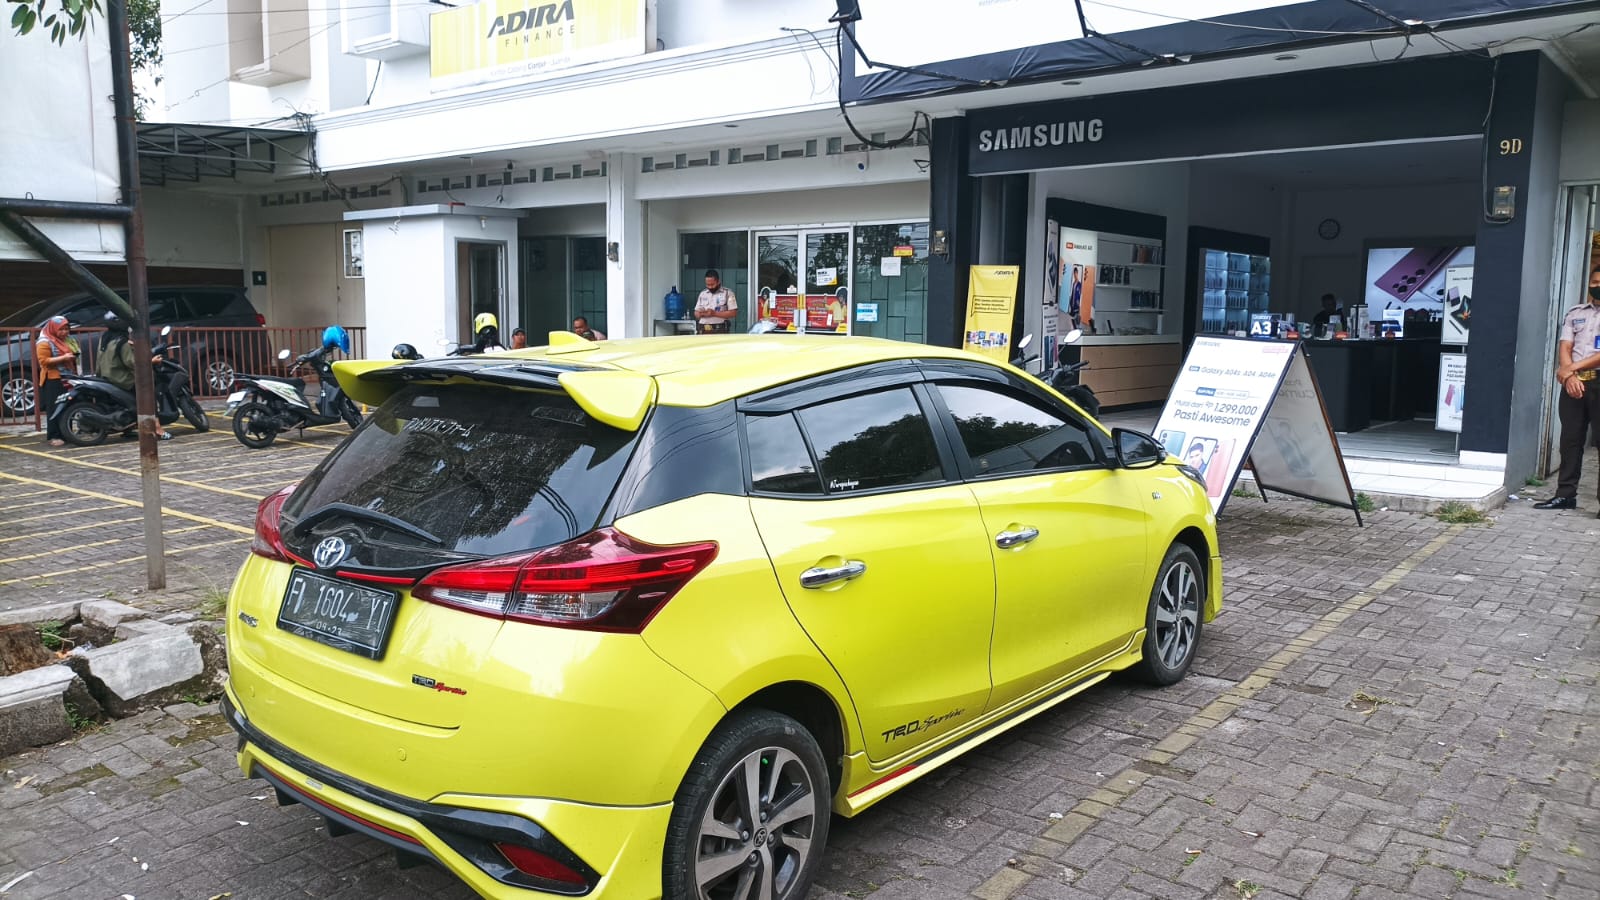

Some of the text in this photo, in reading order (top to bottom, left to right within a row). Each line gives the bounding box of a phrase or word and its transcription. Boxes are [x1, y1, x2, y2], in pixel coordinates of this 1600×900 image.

[487, 0, 574, 39] ADIRA
[505, 24, 575, 48] FINANCE
[979, 118, 1103, 152] SAMSUNG
[1500, 138, 1522, 155] 9D
[1173, 408, 1251, 427] Pasti Awesome
[314, 585, 355, 622] 1604
[881, 719, 920, 743] TRD
